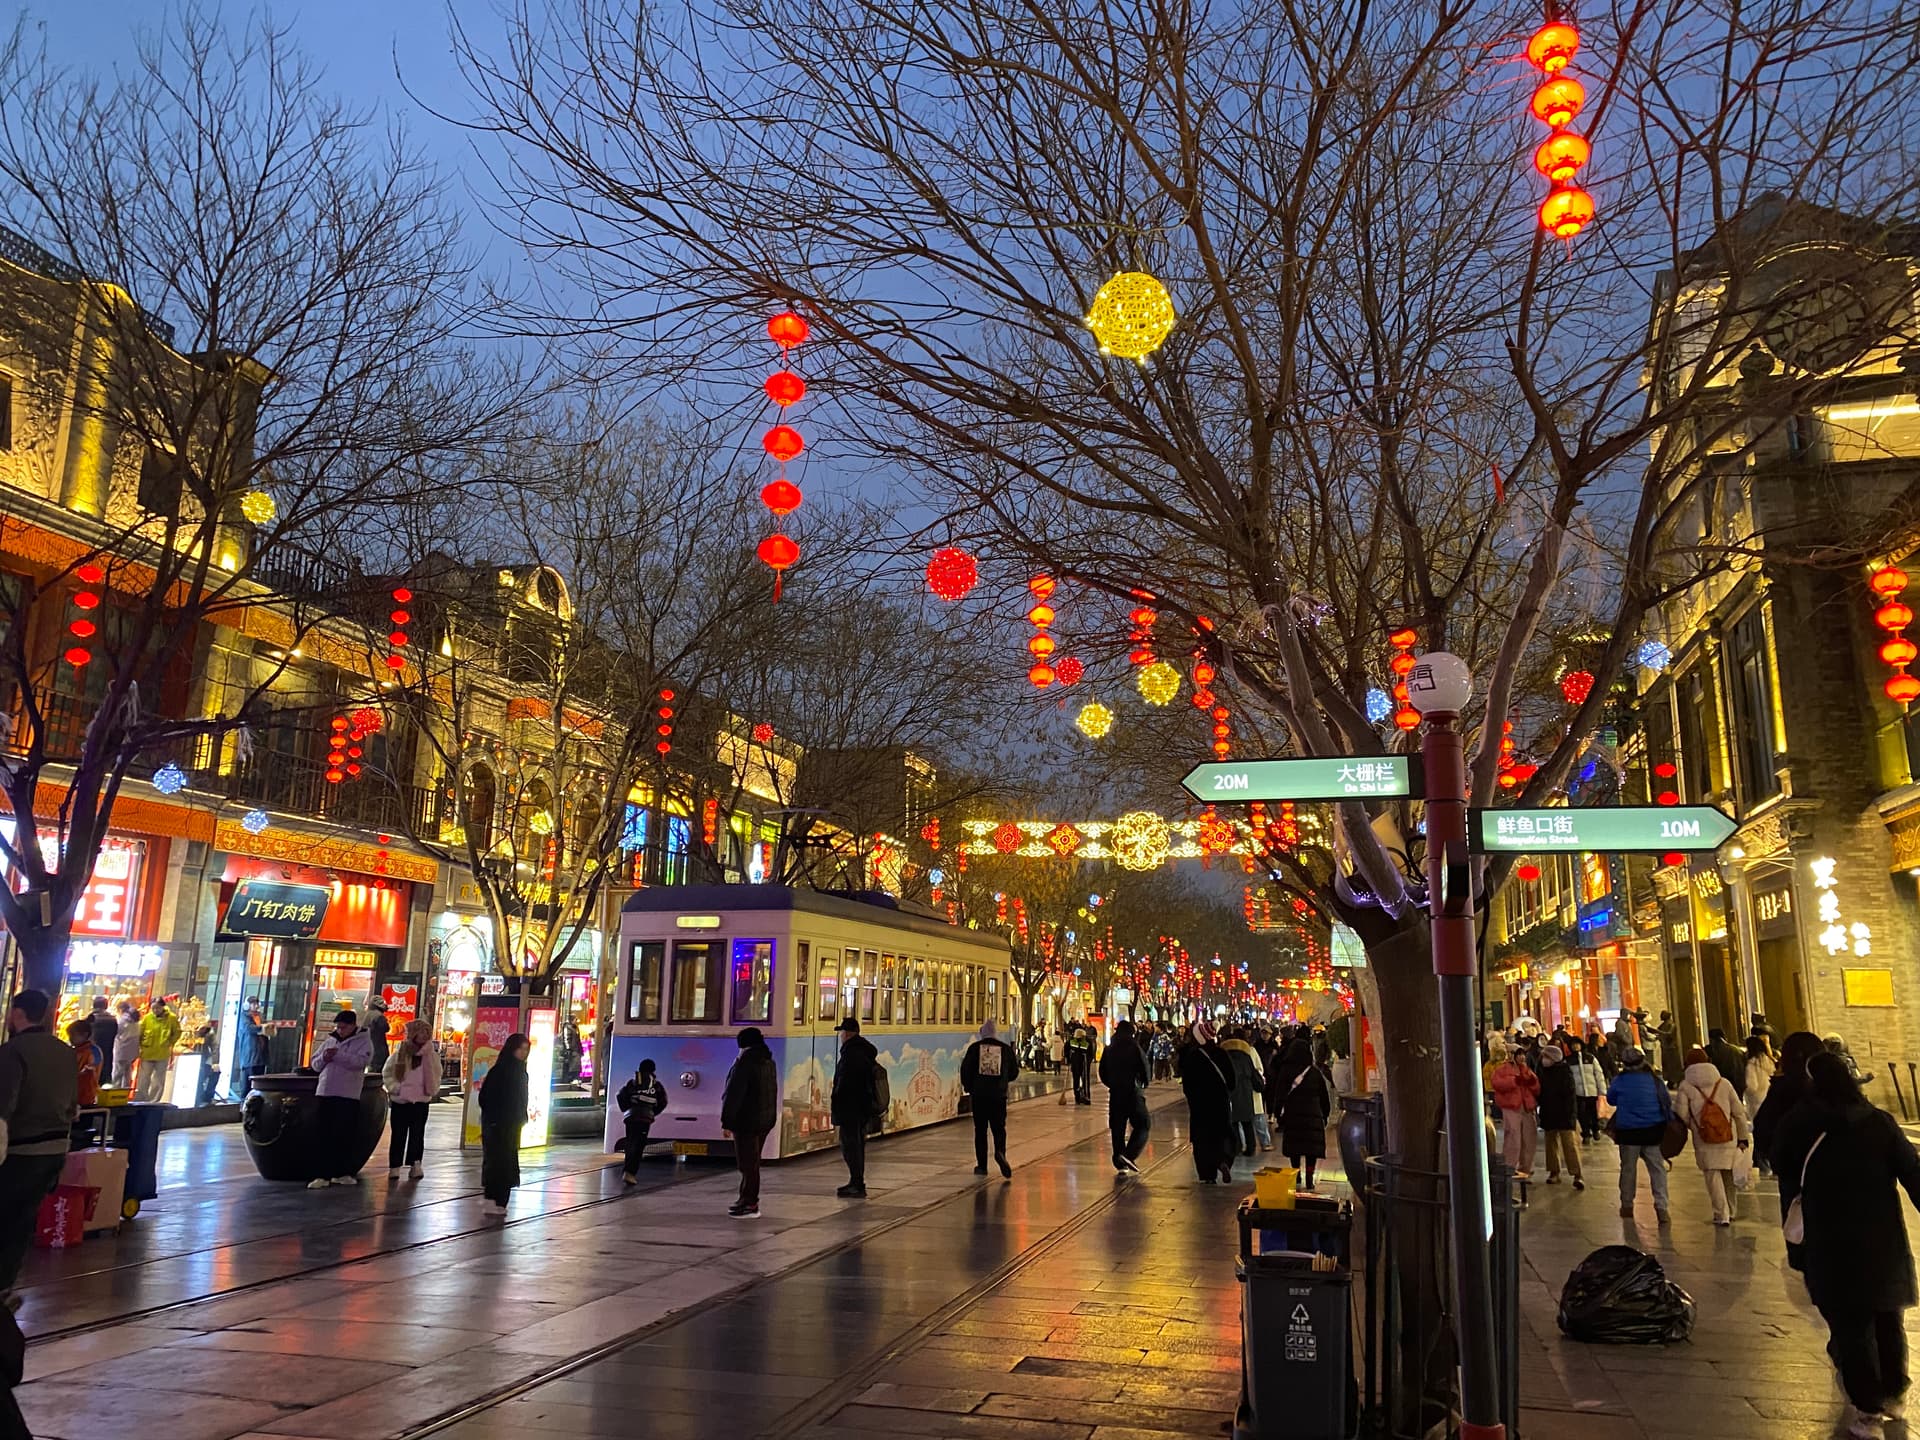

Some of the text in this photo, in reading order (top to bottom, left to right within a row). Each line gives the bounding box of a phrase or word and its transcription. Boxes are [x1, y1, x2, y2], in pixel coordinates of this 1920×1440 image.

[1213, 774, 1249, 790] 20M
[1336, 763, 1396, 783] 大栅栏
[1496, 816, 1573, 834] 鲜鱼口街
[1660, 820, 1701, 837] 10M
[239, 897, 316, 923] 门钉肉饼
